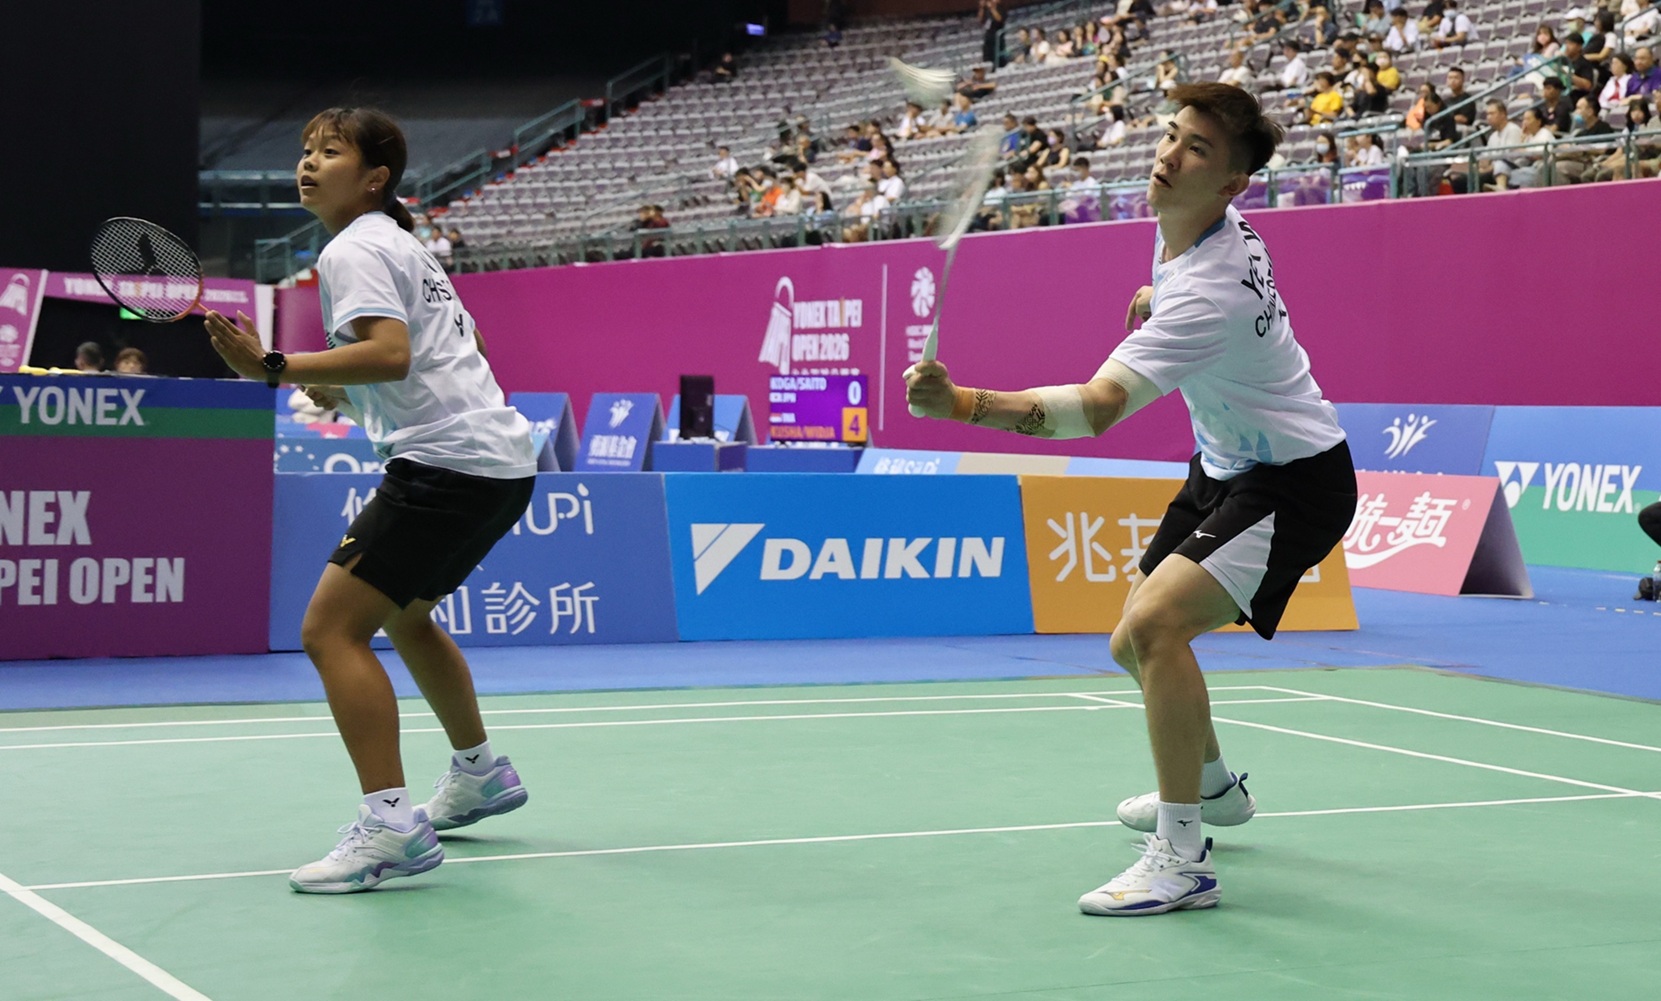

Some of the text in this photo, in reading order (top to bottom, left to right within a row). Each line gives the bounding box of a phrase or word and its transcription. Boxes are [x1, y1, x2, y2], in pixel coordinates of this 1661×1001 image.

[13, 386, 146, 426] YONEX
[847, 380, 862, 406] 0
[848, 414, 860, 437] 4
[1543, 462, 1643, 515] YONEX
[0, 490, 92, 545] NEX
[69, 556, 186, 605] OPEN
[759, 537, 1006, 581] DAIKIN
